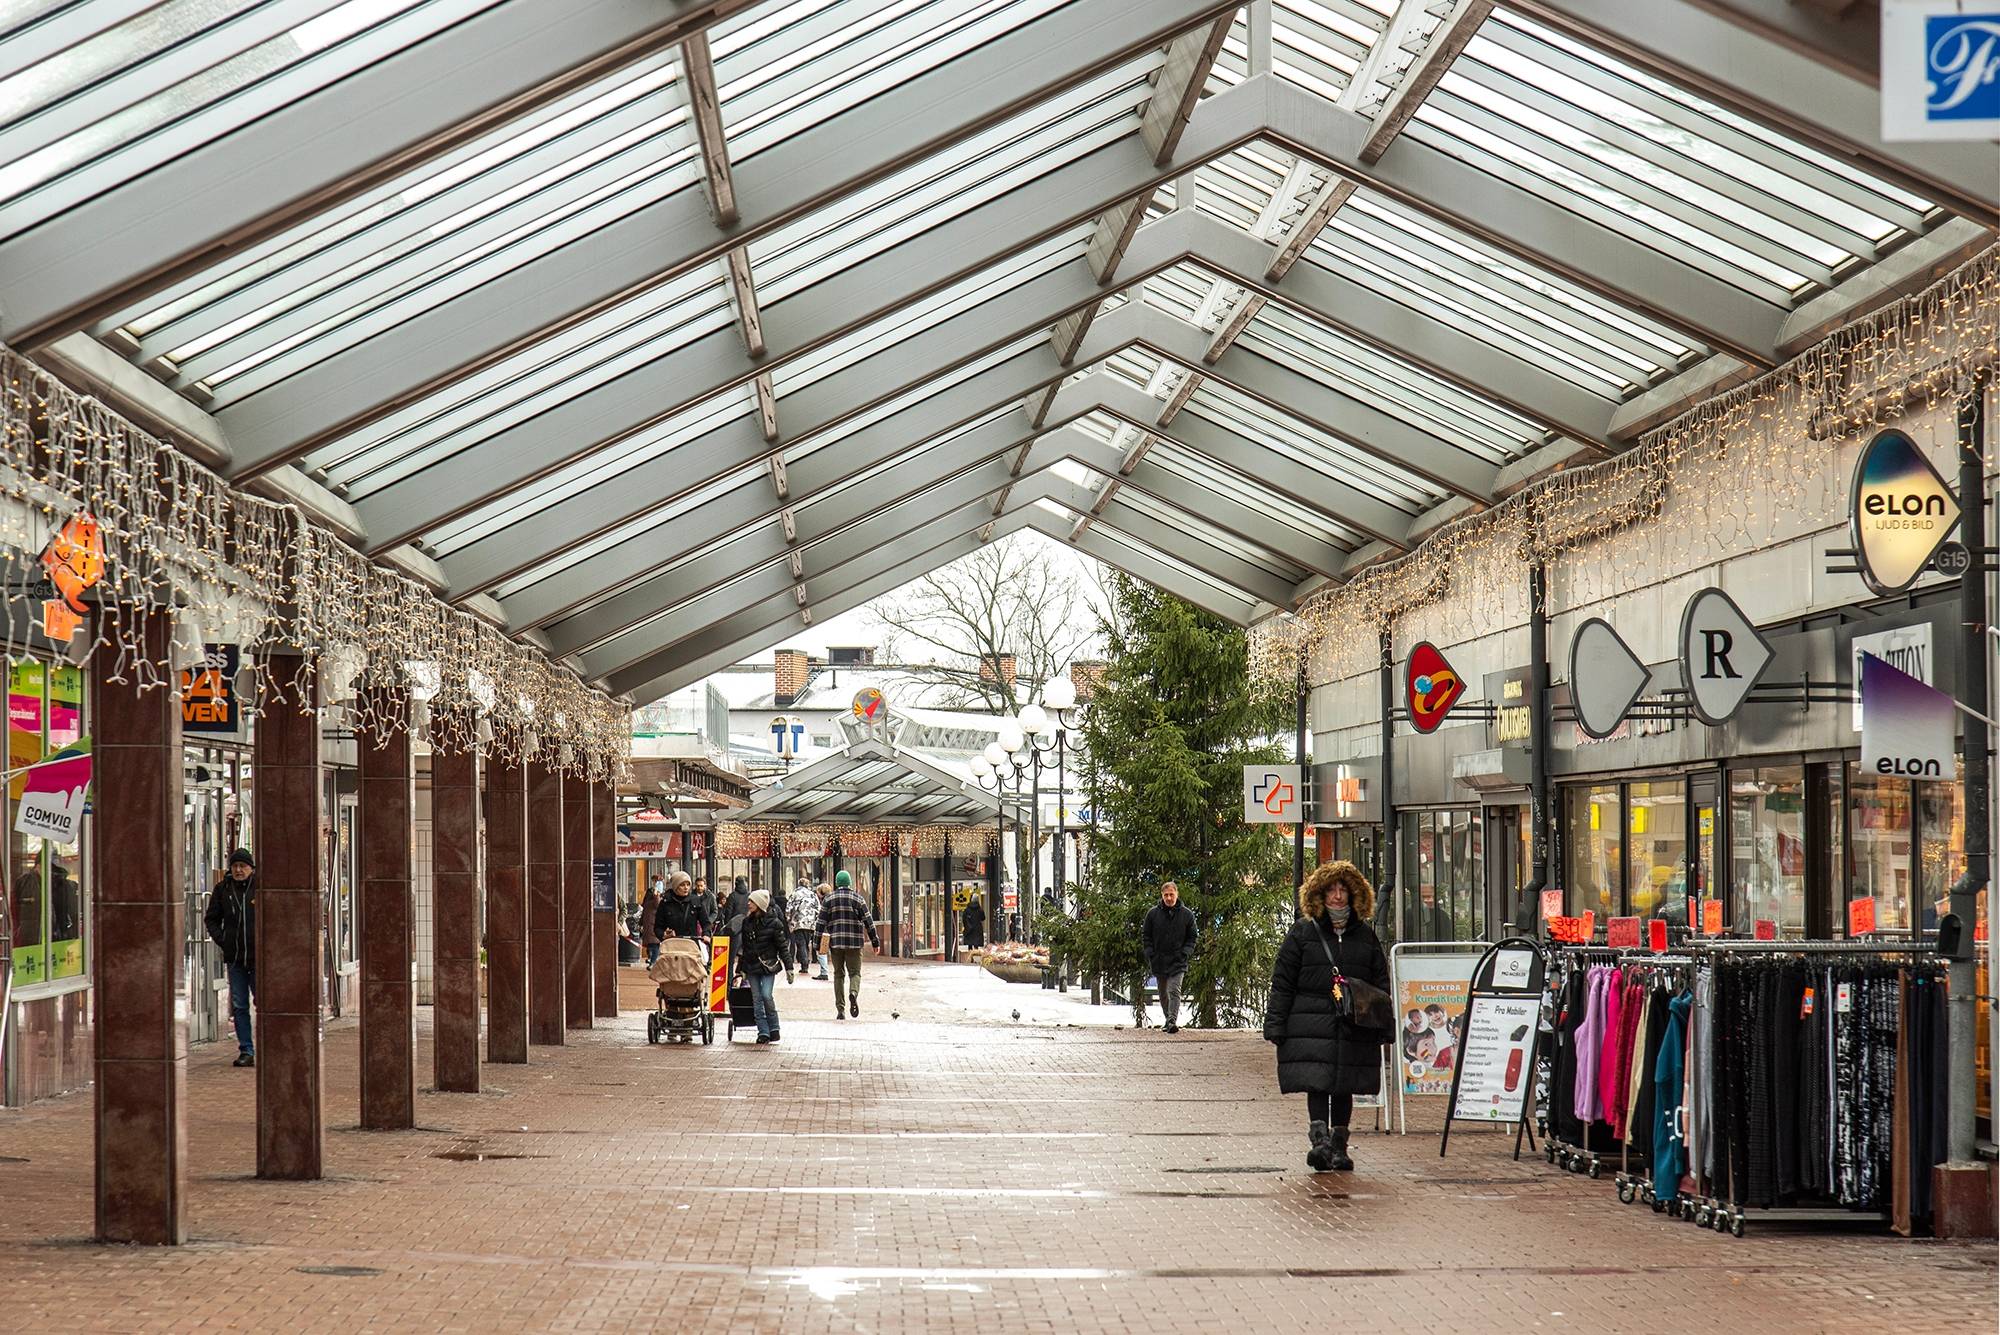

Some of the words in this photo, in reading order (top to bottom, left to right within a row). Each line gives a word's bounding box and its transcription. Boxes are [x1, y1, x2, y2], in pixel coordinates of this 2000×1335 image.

[1876, 520, 1901, 530] LJUD
[1902, 520, 1911, 530] &
[1912, 520, 1934, 530] BILD
[1938, 552, 1967, 568] G15
[1699, 629, 1743, 679] R
[25, 806, 72, 829] COMVIQ
[1421, 984, 1461, 992] LEKEXTRA
